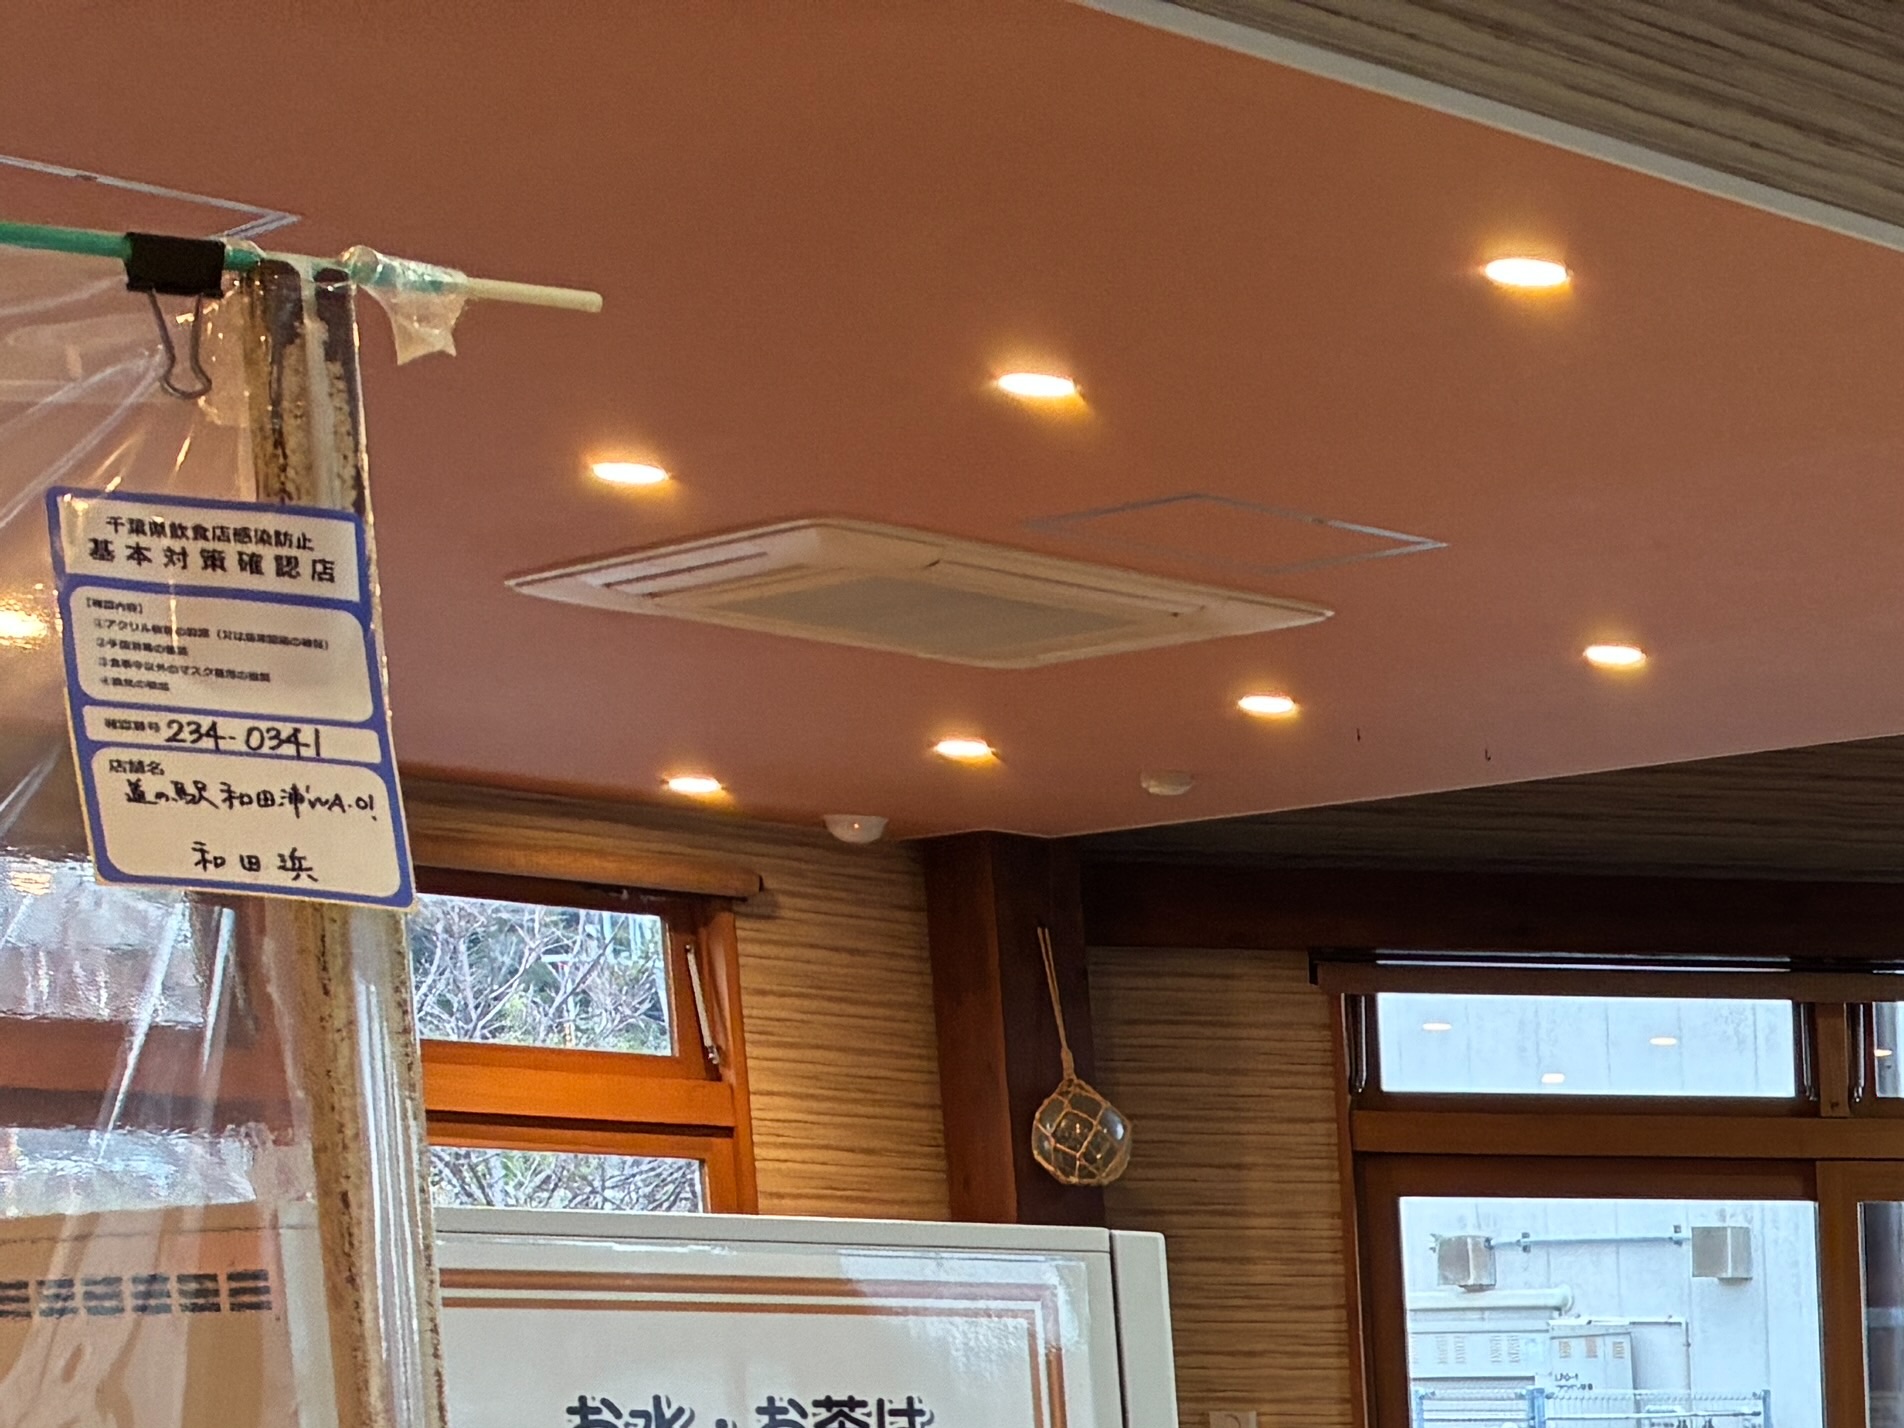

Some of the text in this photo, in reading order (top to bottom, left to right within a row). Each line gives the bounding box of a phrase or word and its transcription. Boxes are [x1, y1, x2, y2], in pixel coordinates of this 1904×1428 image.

[105, 516, 315, 553] 千葉県飲食店感染防止
[88, 537, 336, 584] 基本対策確認店
[108, 758, 165, 776] 店舗名
